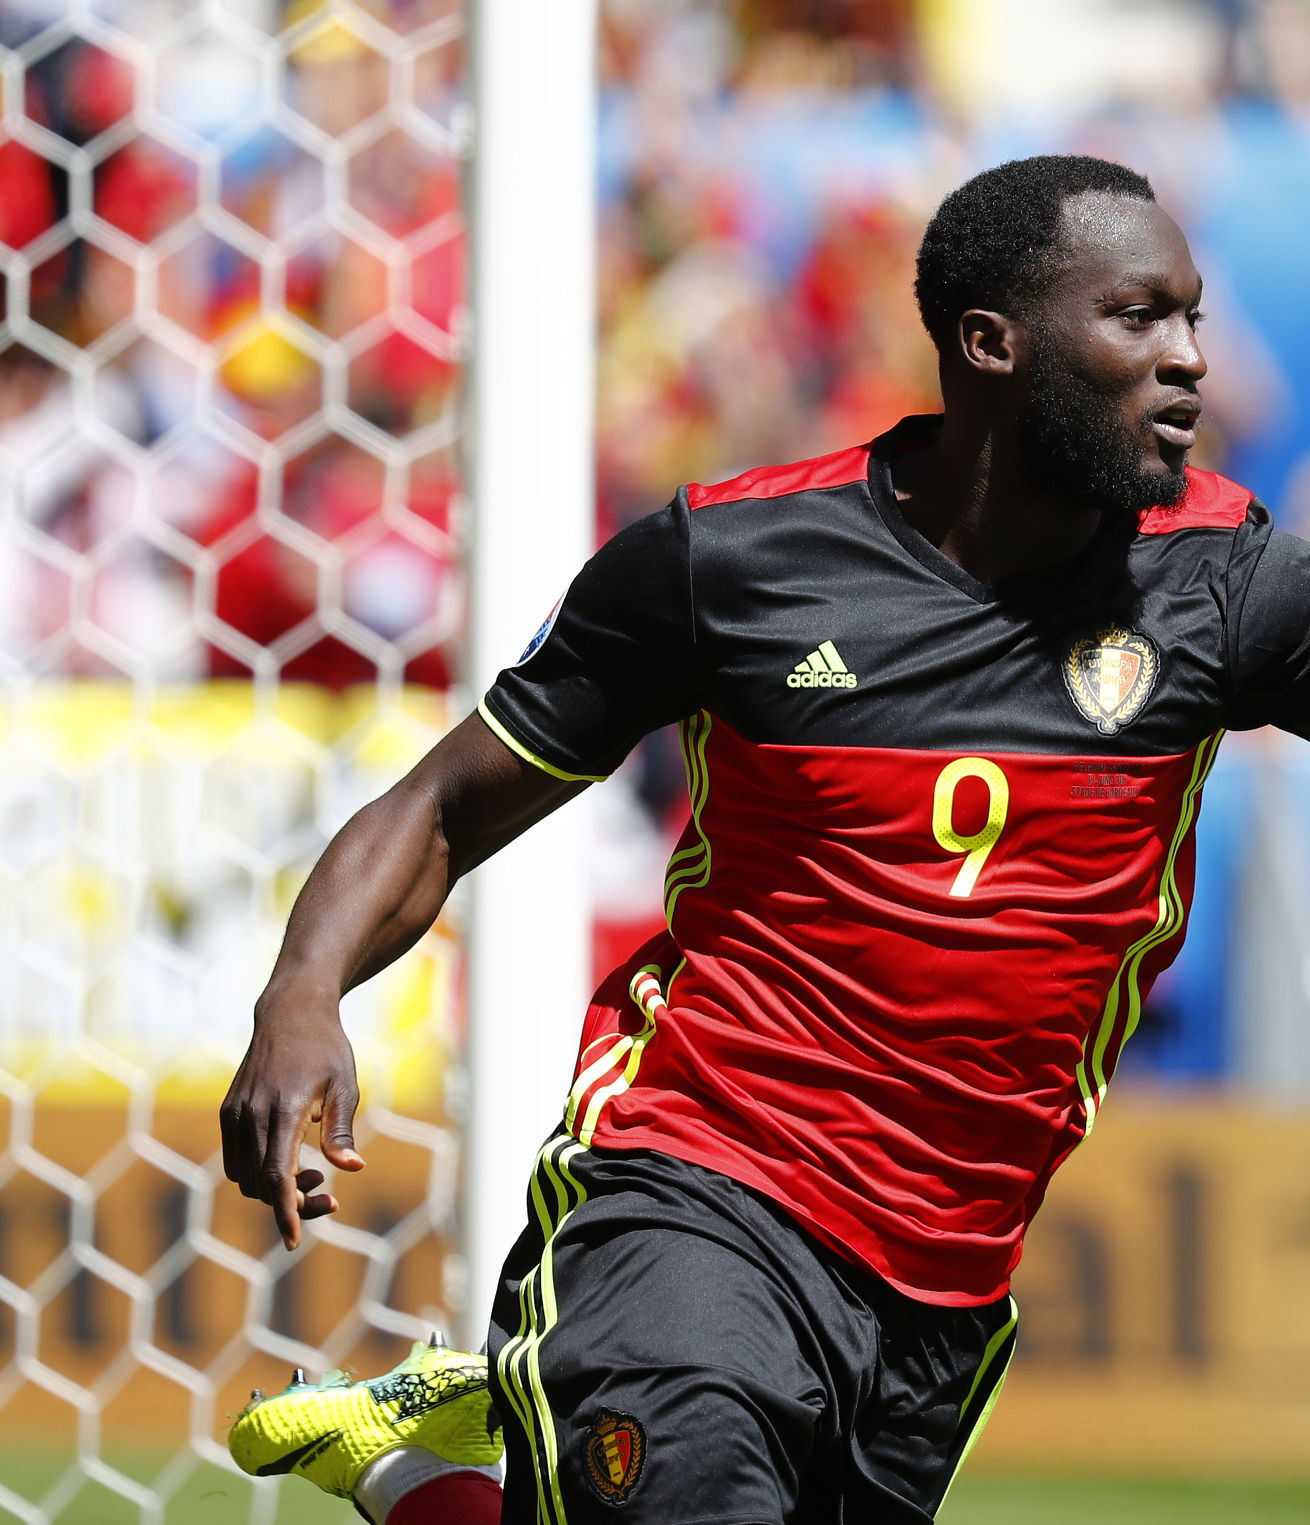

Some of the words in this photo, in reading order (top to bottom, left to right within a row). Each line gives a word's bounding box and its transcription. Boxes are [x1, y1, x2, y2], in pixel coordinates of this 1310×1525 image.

[786, 670, 858, 689] adidas
[1070, 786, 1095, 797] STADE
[932, 757, 1010, 898] 9
